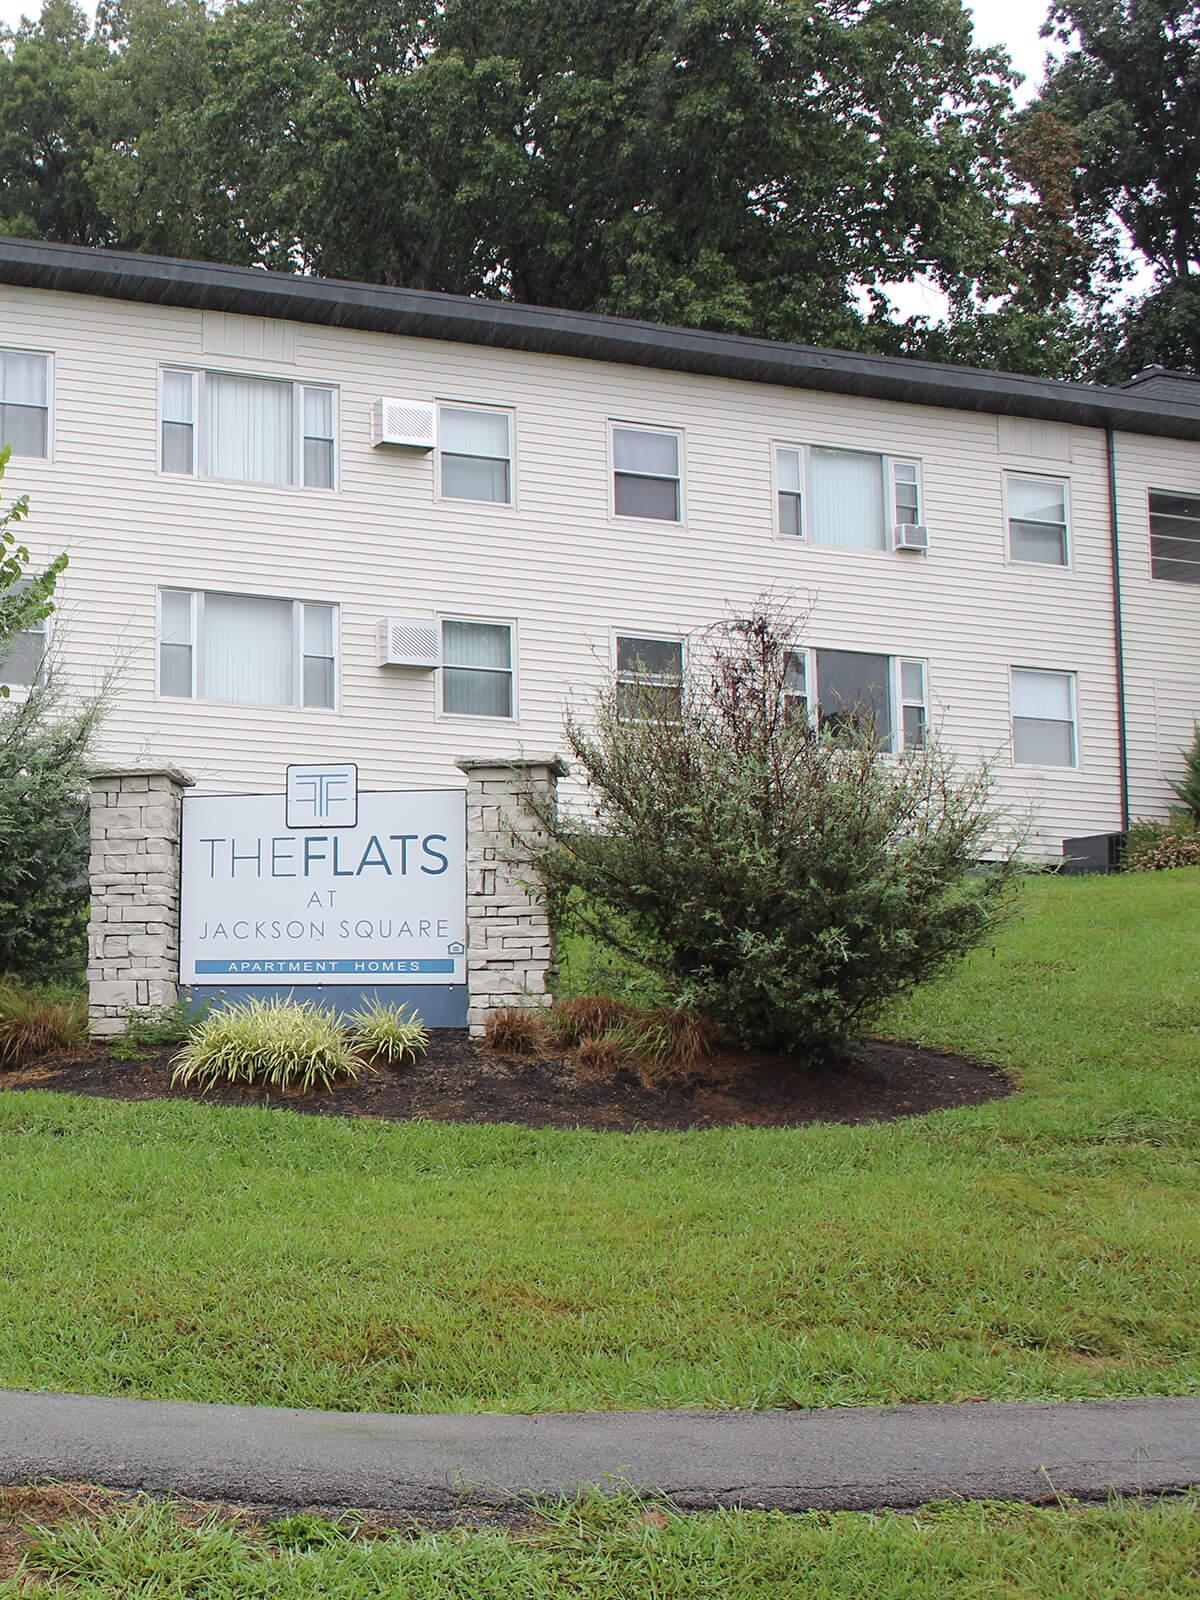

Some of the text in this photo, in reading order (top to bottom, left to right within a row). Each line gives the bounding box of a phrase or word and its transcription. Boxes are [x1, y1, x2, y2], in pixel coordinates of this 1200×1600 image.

[306, 889, 337, 908] AT
[199, 919, 449, 940] JACKSON SQUARE
[228, 961, 420, 972] APARTMENT HOMES
